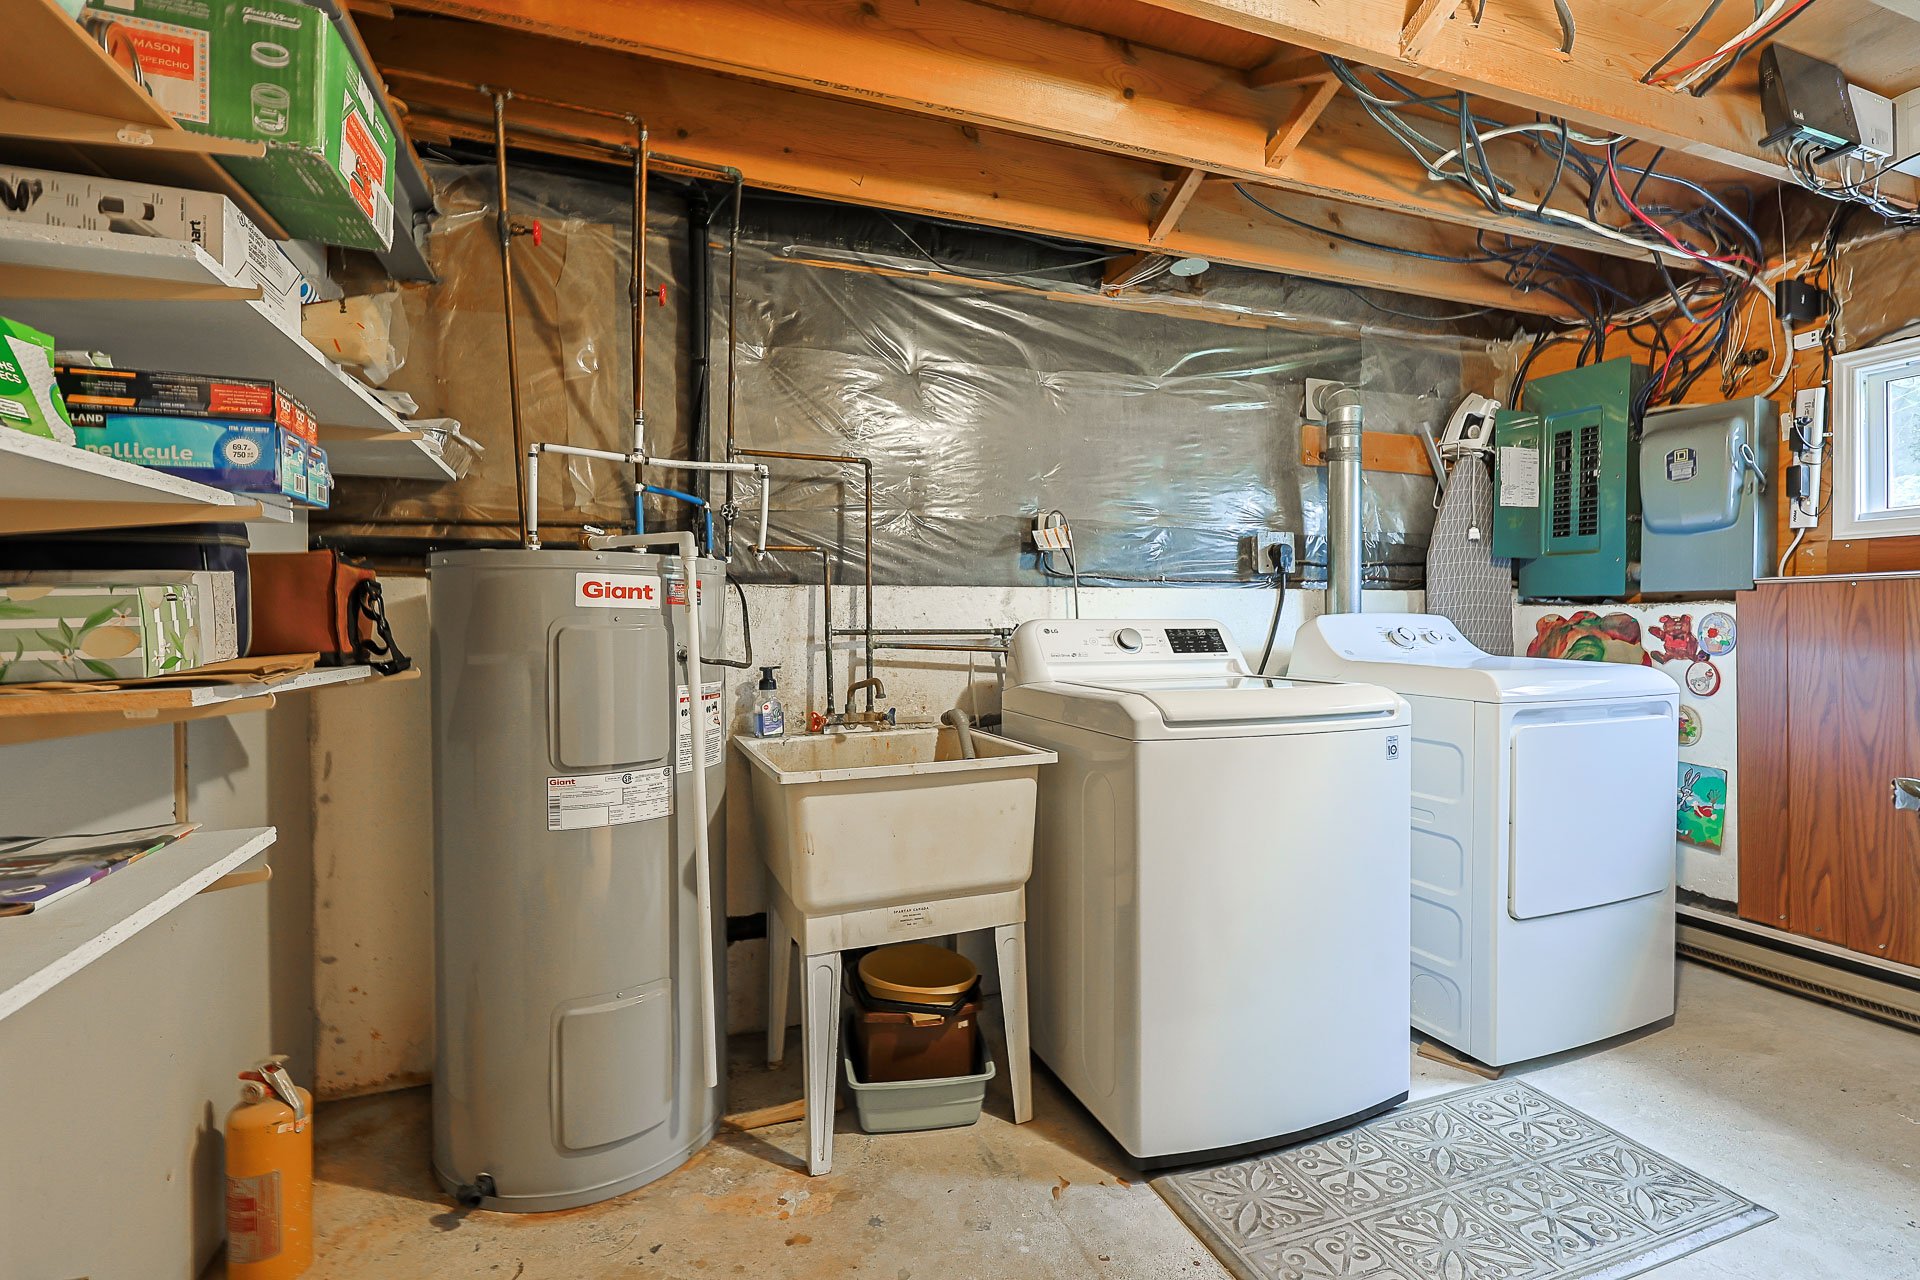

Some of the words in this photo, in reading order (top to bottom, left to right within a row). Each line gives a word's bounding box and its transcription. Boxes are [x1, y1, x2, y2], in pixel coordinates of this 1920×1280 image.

[133, 37, 181, 54] MASON
[1793, 110, 1805, 121] Bell
[1100, 138, 1159, 156] KILN-DRIED
[582, 580, 653, 600] Giant
[549, 778, 576, 786] Giant
